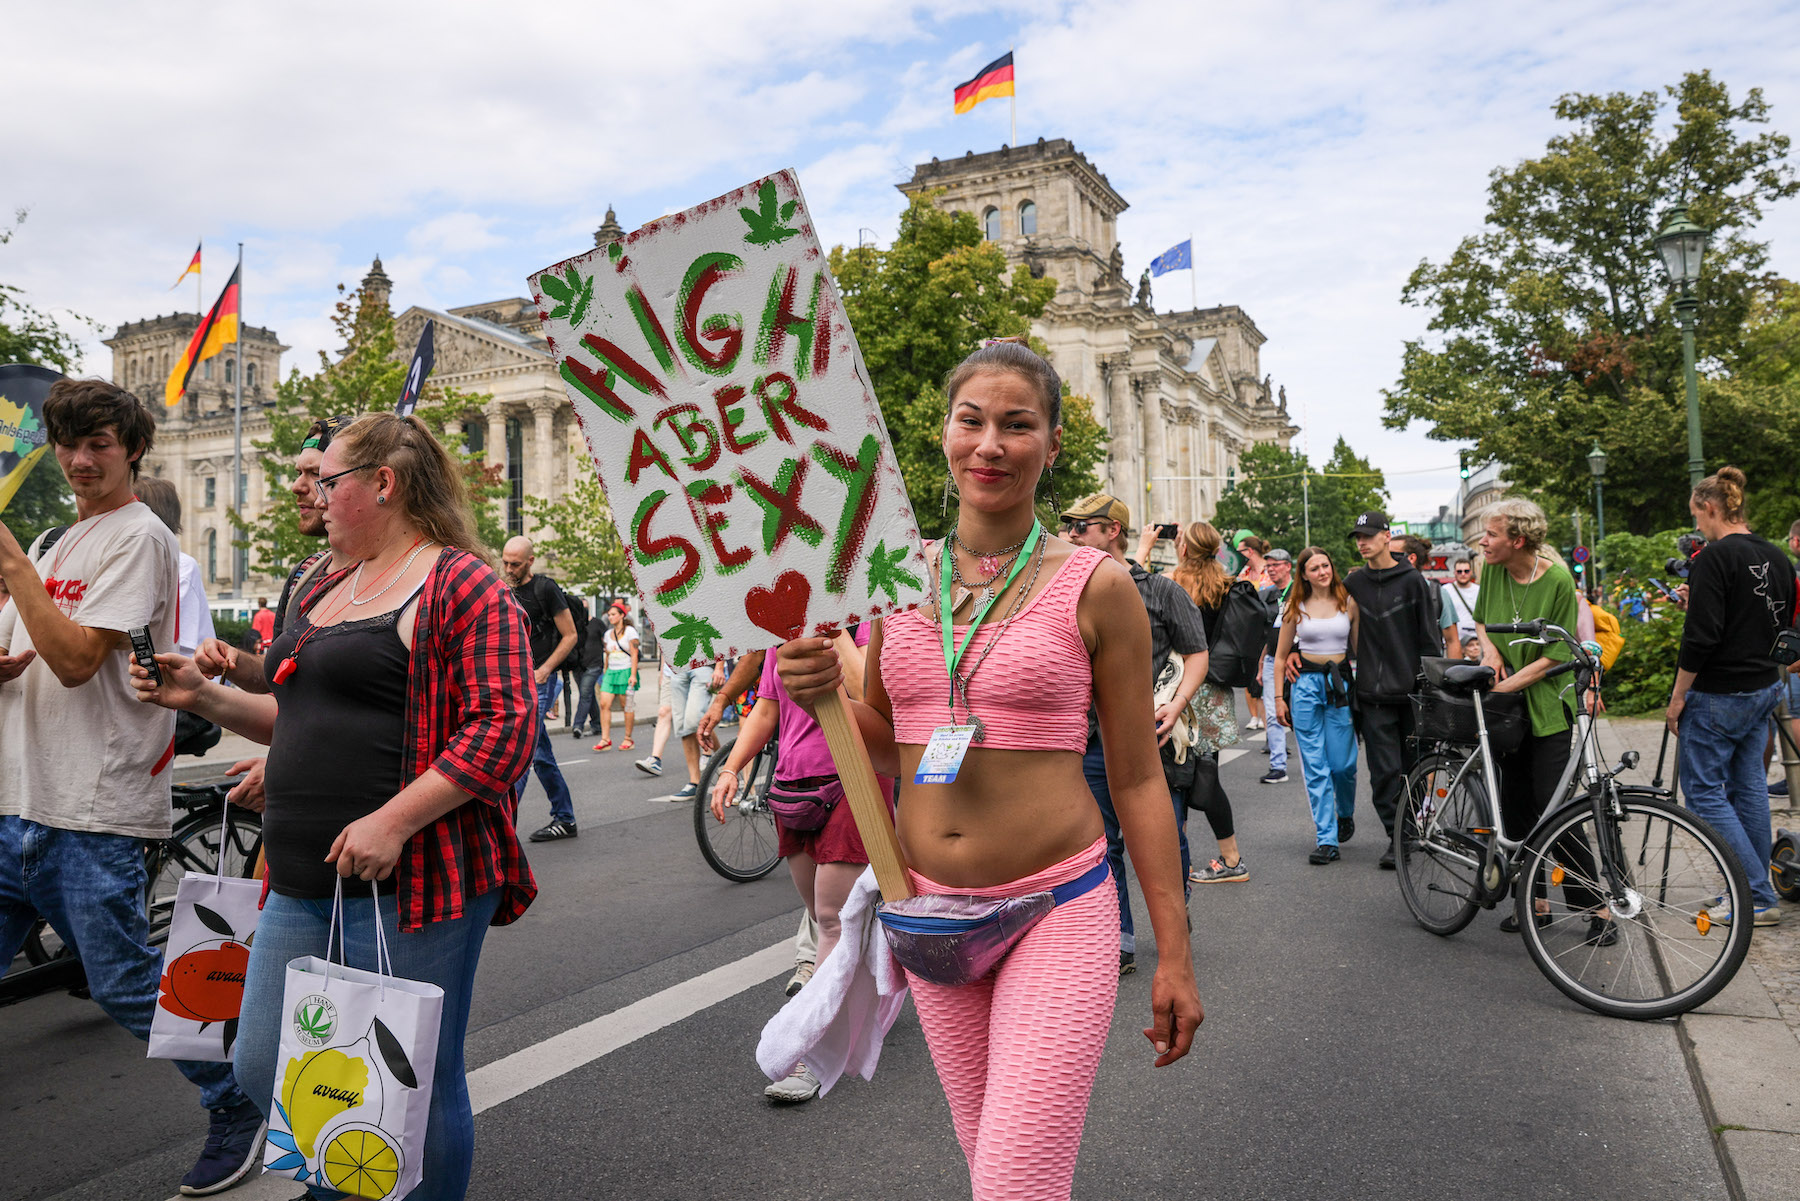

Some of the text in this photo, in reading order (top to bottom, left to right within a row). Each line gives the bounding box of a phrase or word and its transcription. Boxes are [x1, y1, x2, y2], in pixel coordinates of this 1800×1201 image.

[624, 372, 832, 483] ABER
[630, 433, 883, 607] SEXY
[922, 774, 948, 783] TEAM
[313, 996, 335, 1012] HANF
[296, 1026, 320, 1045] MUSEUM
[313, 1084, 359, 1108] avaay
